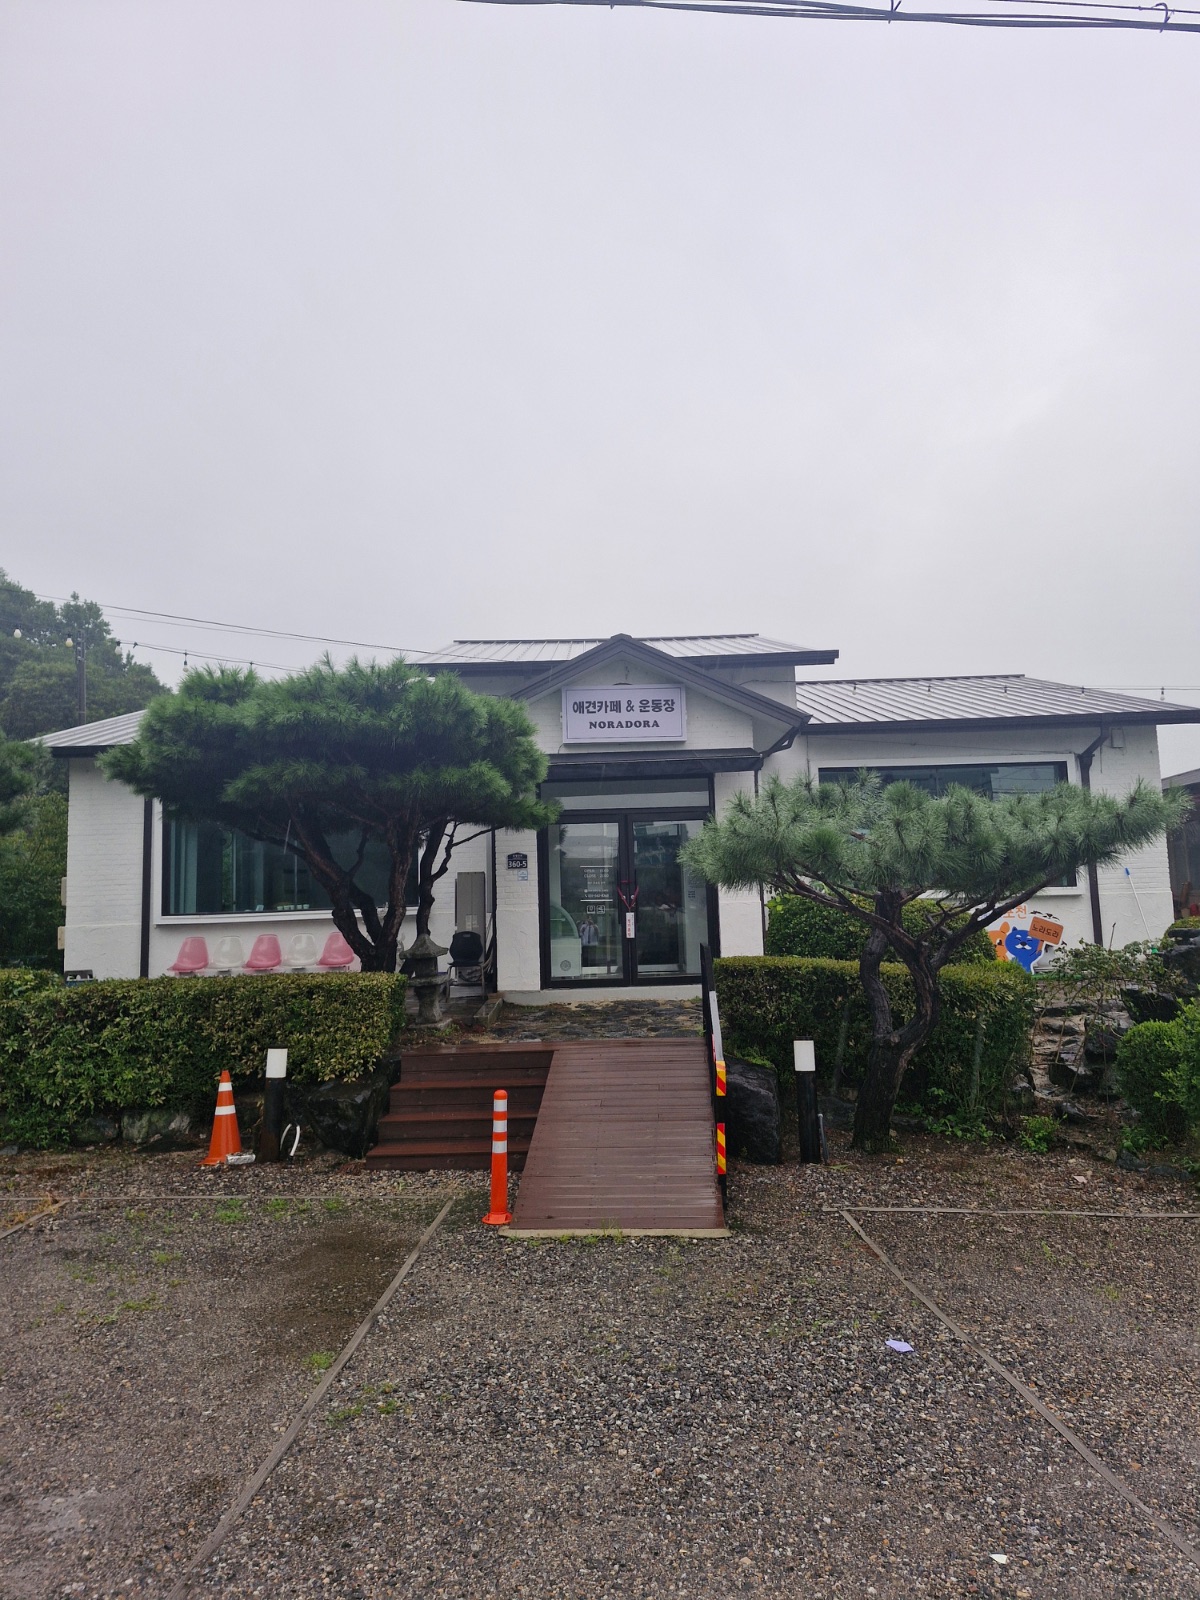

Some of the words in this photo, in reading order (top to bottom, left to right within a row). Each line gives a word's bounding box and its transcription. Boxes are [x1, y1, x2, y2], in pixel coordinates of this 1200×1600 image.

[572, 700, 622, 714] 애견카페
[625, 700, 635, 713] &
[639, 699, 675, 713] 운동장
[589, 720, 660, 729] NORADORA
[508, 860, 527, 868] 360-5
[1032, 924, 1059, 938] 노라도라
